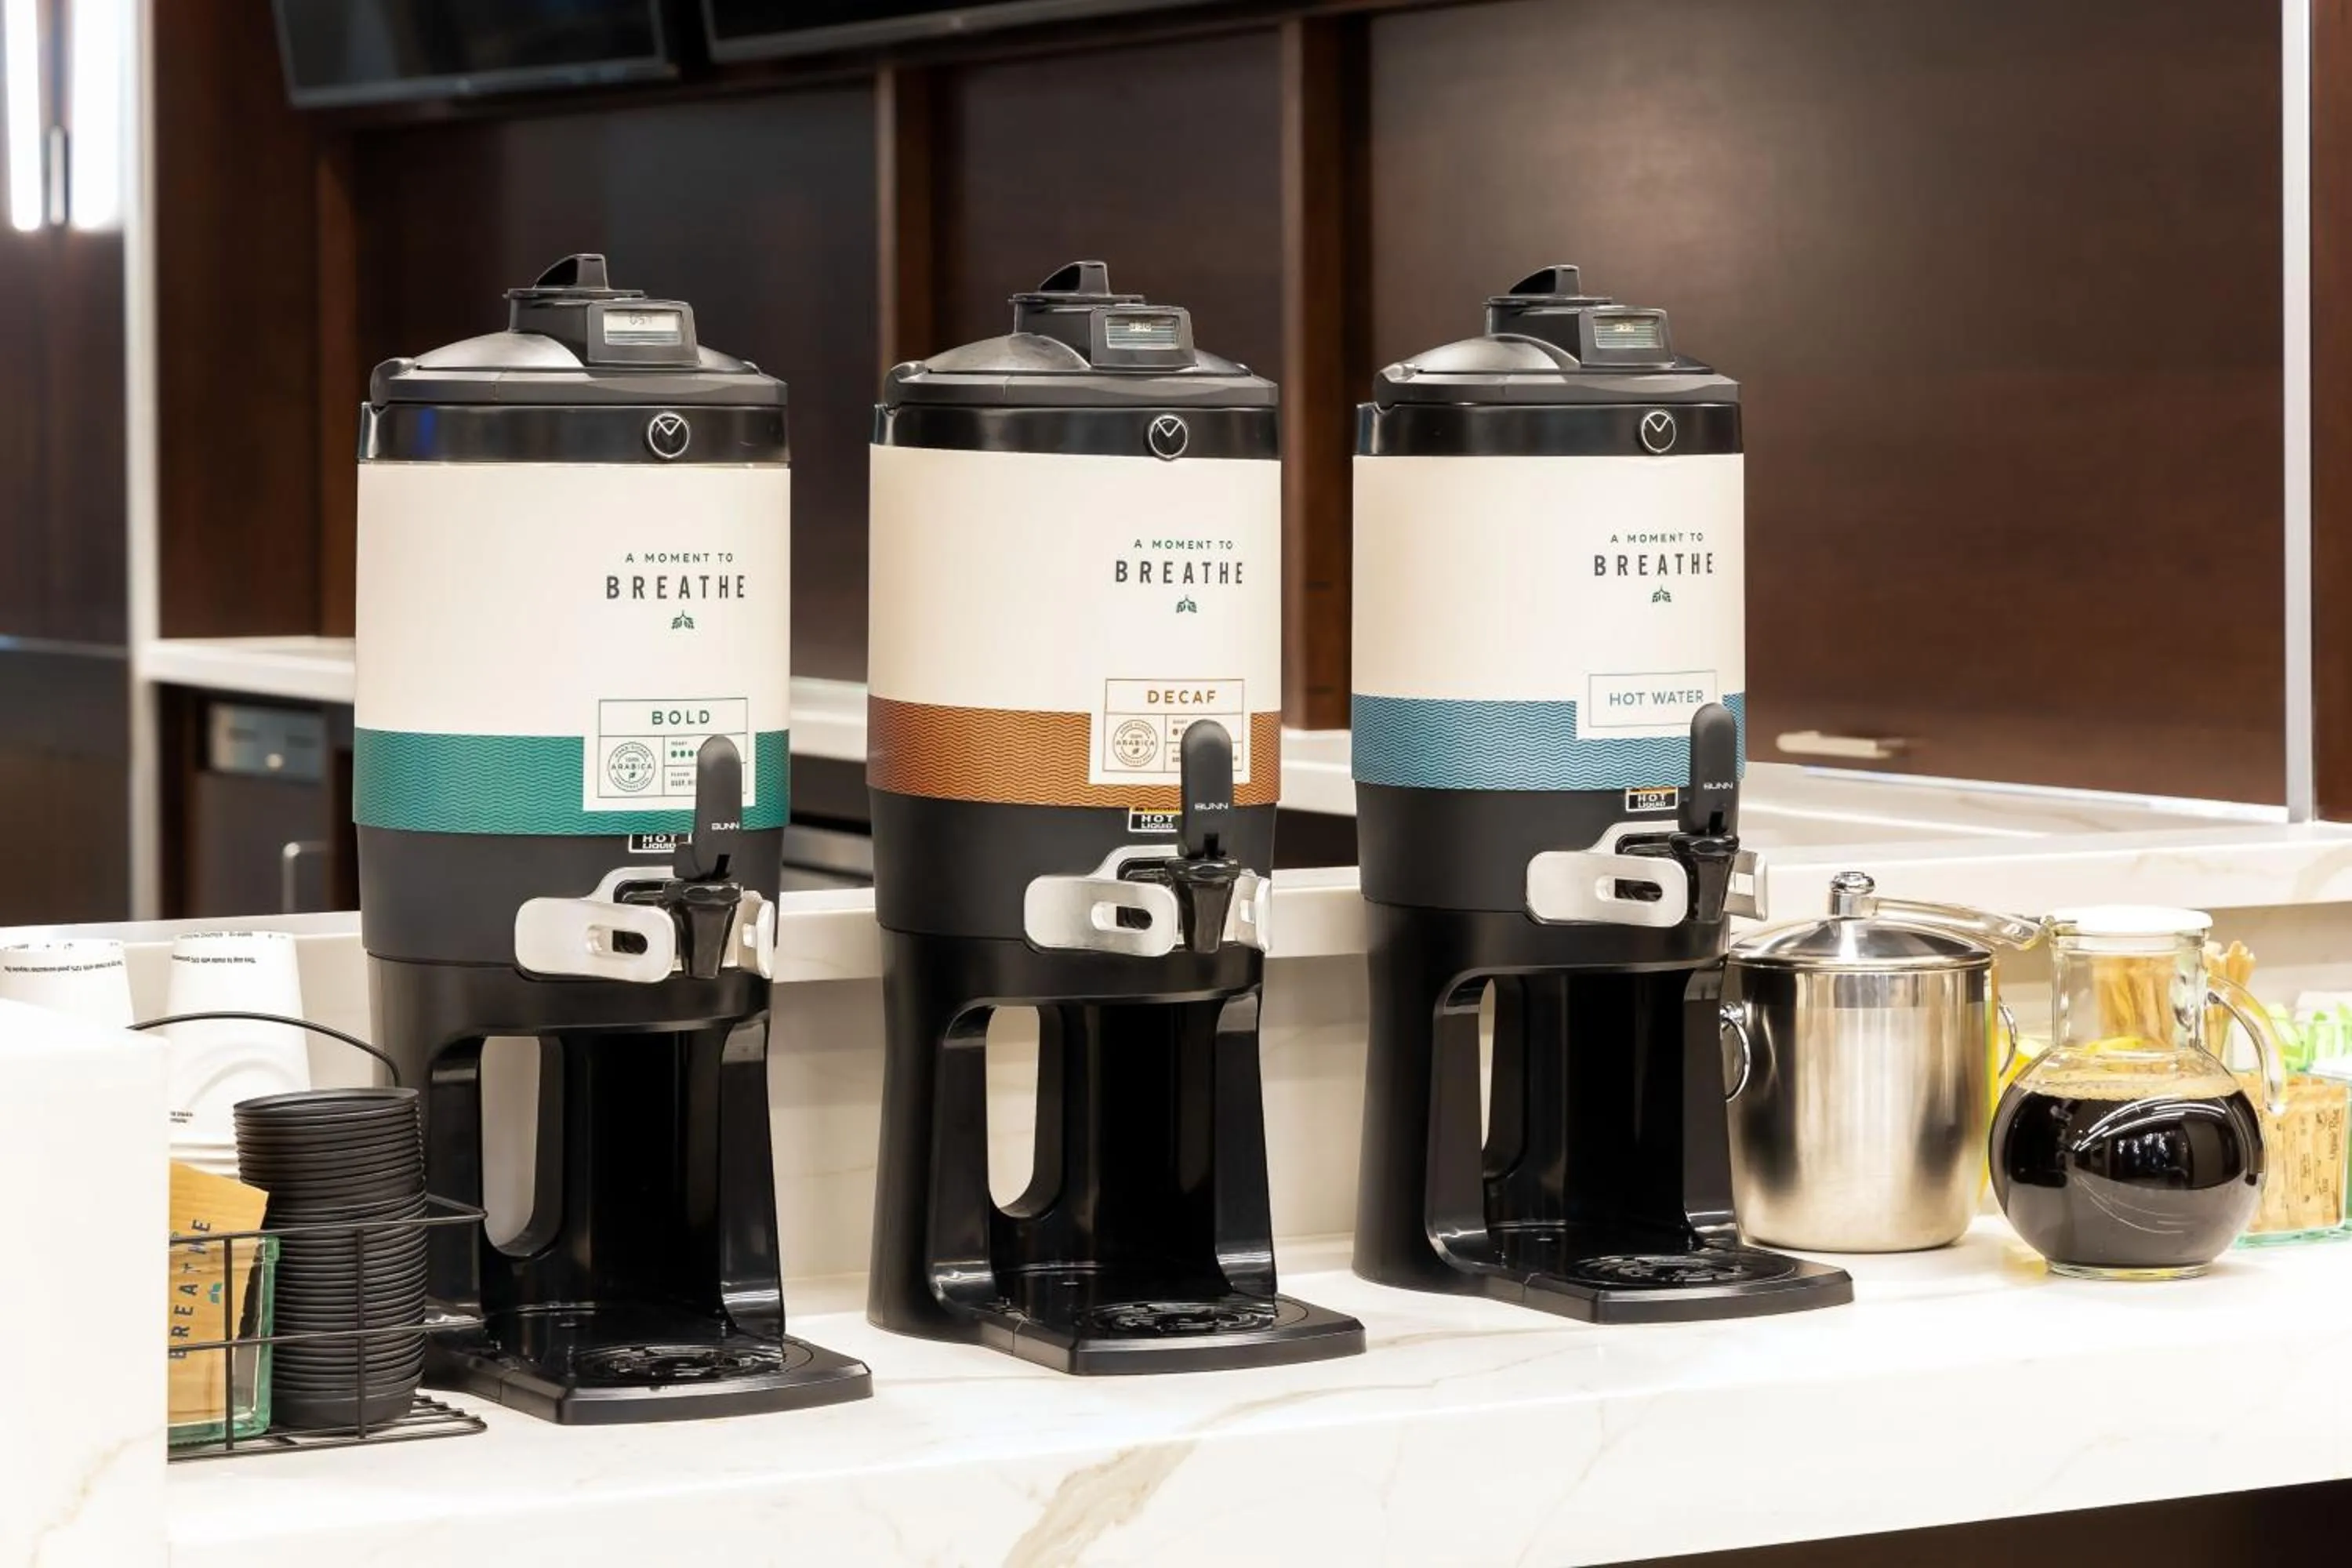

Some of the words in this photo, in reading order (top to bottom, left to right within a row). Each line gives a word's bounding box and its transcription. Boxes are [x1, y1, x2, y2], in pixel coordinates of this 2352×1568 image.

[1610, 534, 1619, 543] A
[1627, 533, 1684, 543] MOMENT
[1690, 532, 1704, 542] TO
[1134, 539, 1142, 548] A
[1152, 539, 1212, 550] MOMENT
[1218, 540, 1233, 550] TO
[625, 553, 634, 563] A
[644, 553, 710, 563] MOMENT
[717, 553, 733, 563] TO
[1593, 553, 1713, 576] BREATHE
[1115, 560, 1243, 584] BREATHE
[606, 575, 745, 600] BREATHE
[1147, 690, 1216, 704] DECAF
[1610, 692, 1646, 706] HOT
[1652, 690, 1704, 705] WATER
[652, 710, 710, 725] BOLD
[1194, 802, 1229, 811] BUNN
[711, 822, 740, 831] BUNN
[642, 834, 677, 843] HOT
